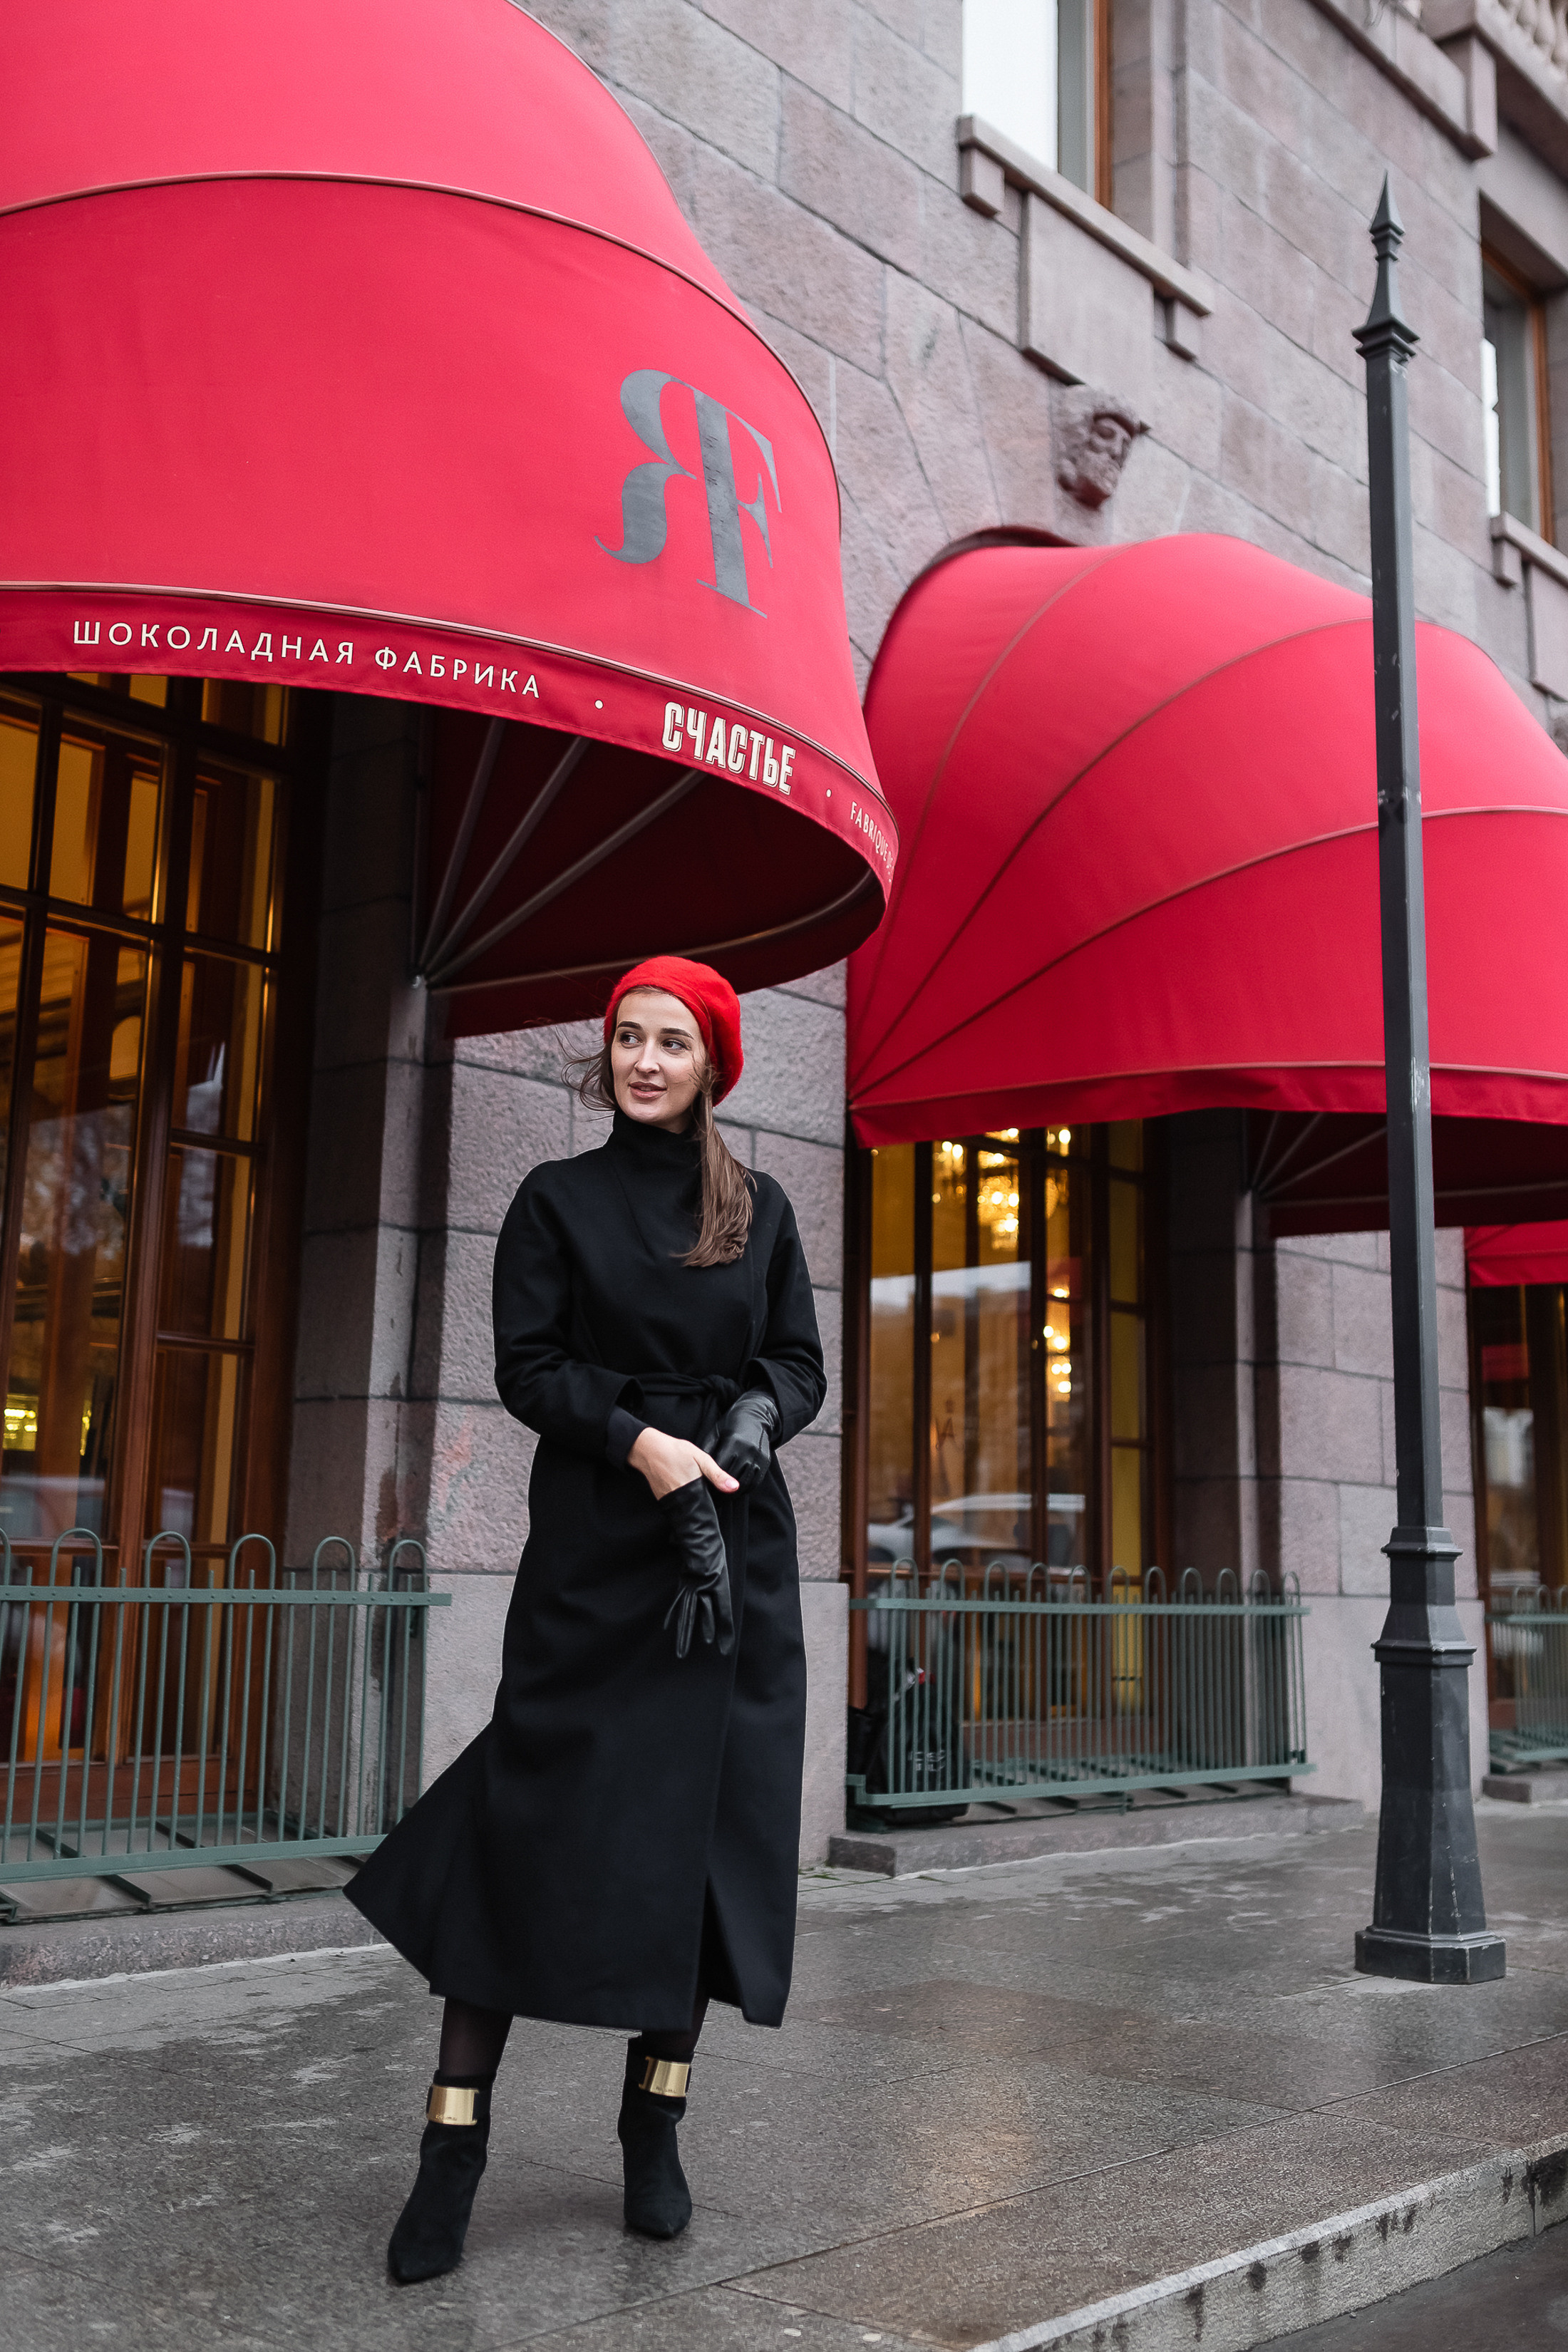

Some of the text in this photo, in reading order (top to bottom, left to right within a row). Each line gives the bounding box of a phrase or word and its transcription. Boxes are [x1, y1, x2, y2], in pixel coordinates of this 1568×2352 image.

[73, 620, 540, 698] ШОКОЛАДНАЯ ФАБРИКА
[662, 701, 796, 795] СЧАСТЬЕ
[850, 801, 889, 862] FABRIQUE
